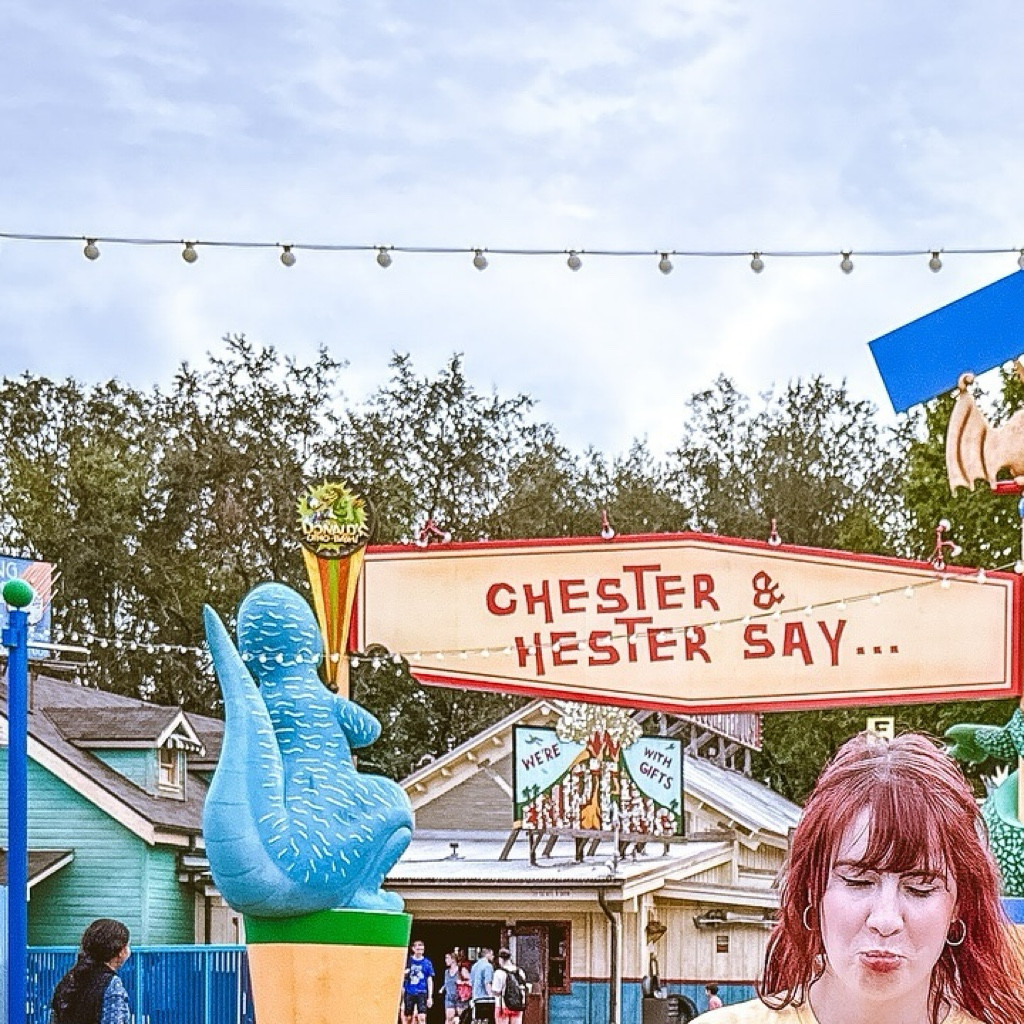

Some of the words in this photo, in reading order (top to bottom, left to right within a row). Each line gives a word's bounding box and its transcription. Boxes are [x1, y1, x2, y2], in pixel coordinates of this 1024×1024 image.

[485, 564, 719, 624] CHESTER
[752, 570, 783, 610] &
[514, 616, 711, 676] HESTER
[742, 618, 900, 667] SAY...
[521, 743, 561, 771] WE'RE
[643, 747, 673, 769] WITH
[639, 761, 674, 790] GIFTS
